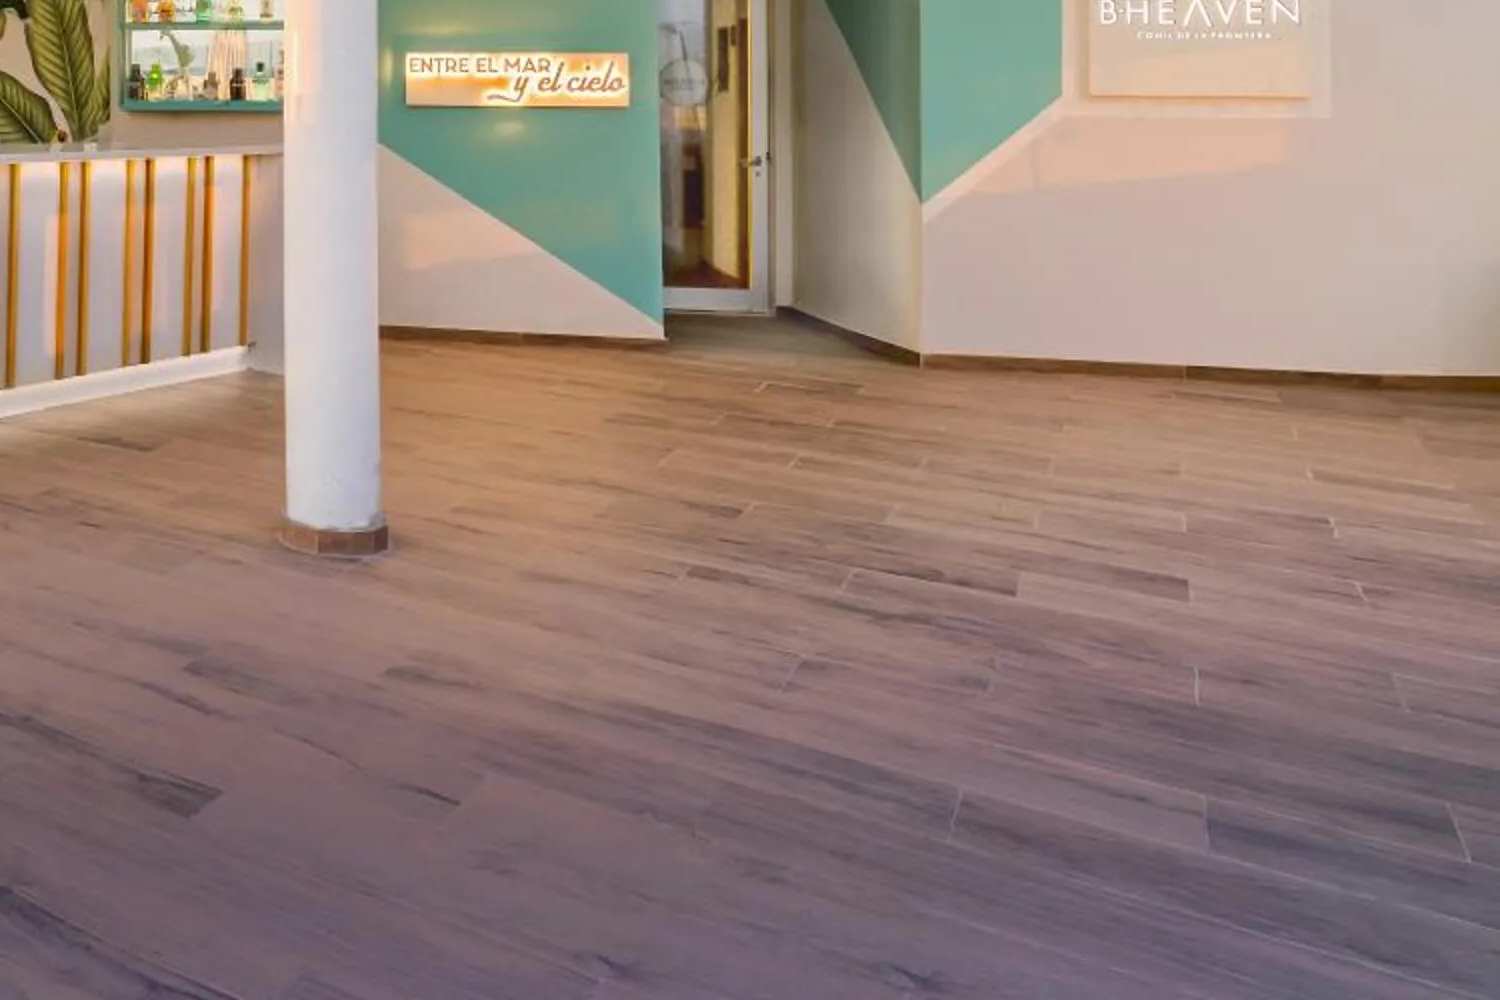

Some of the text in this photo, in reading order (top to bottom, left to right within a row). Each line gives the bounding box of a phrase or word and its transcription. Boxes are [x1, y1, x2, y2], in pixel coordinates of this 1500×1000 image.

[409, 57, 551, 73] ENTRE EL MAR
[487, 61, 625, 102] y el cielo
